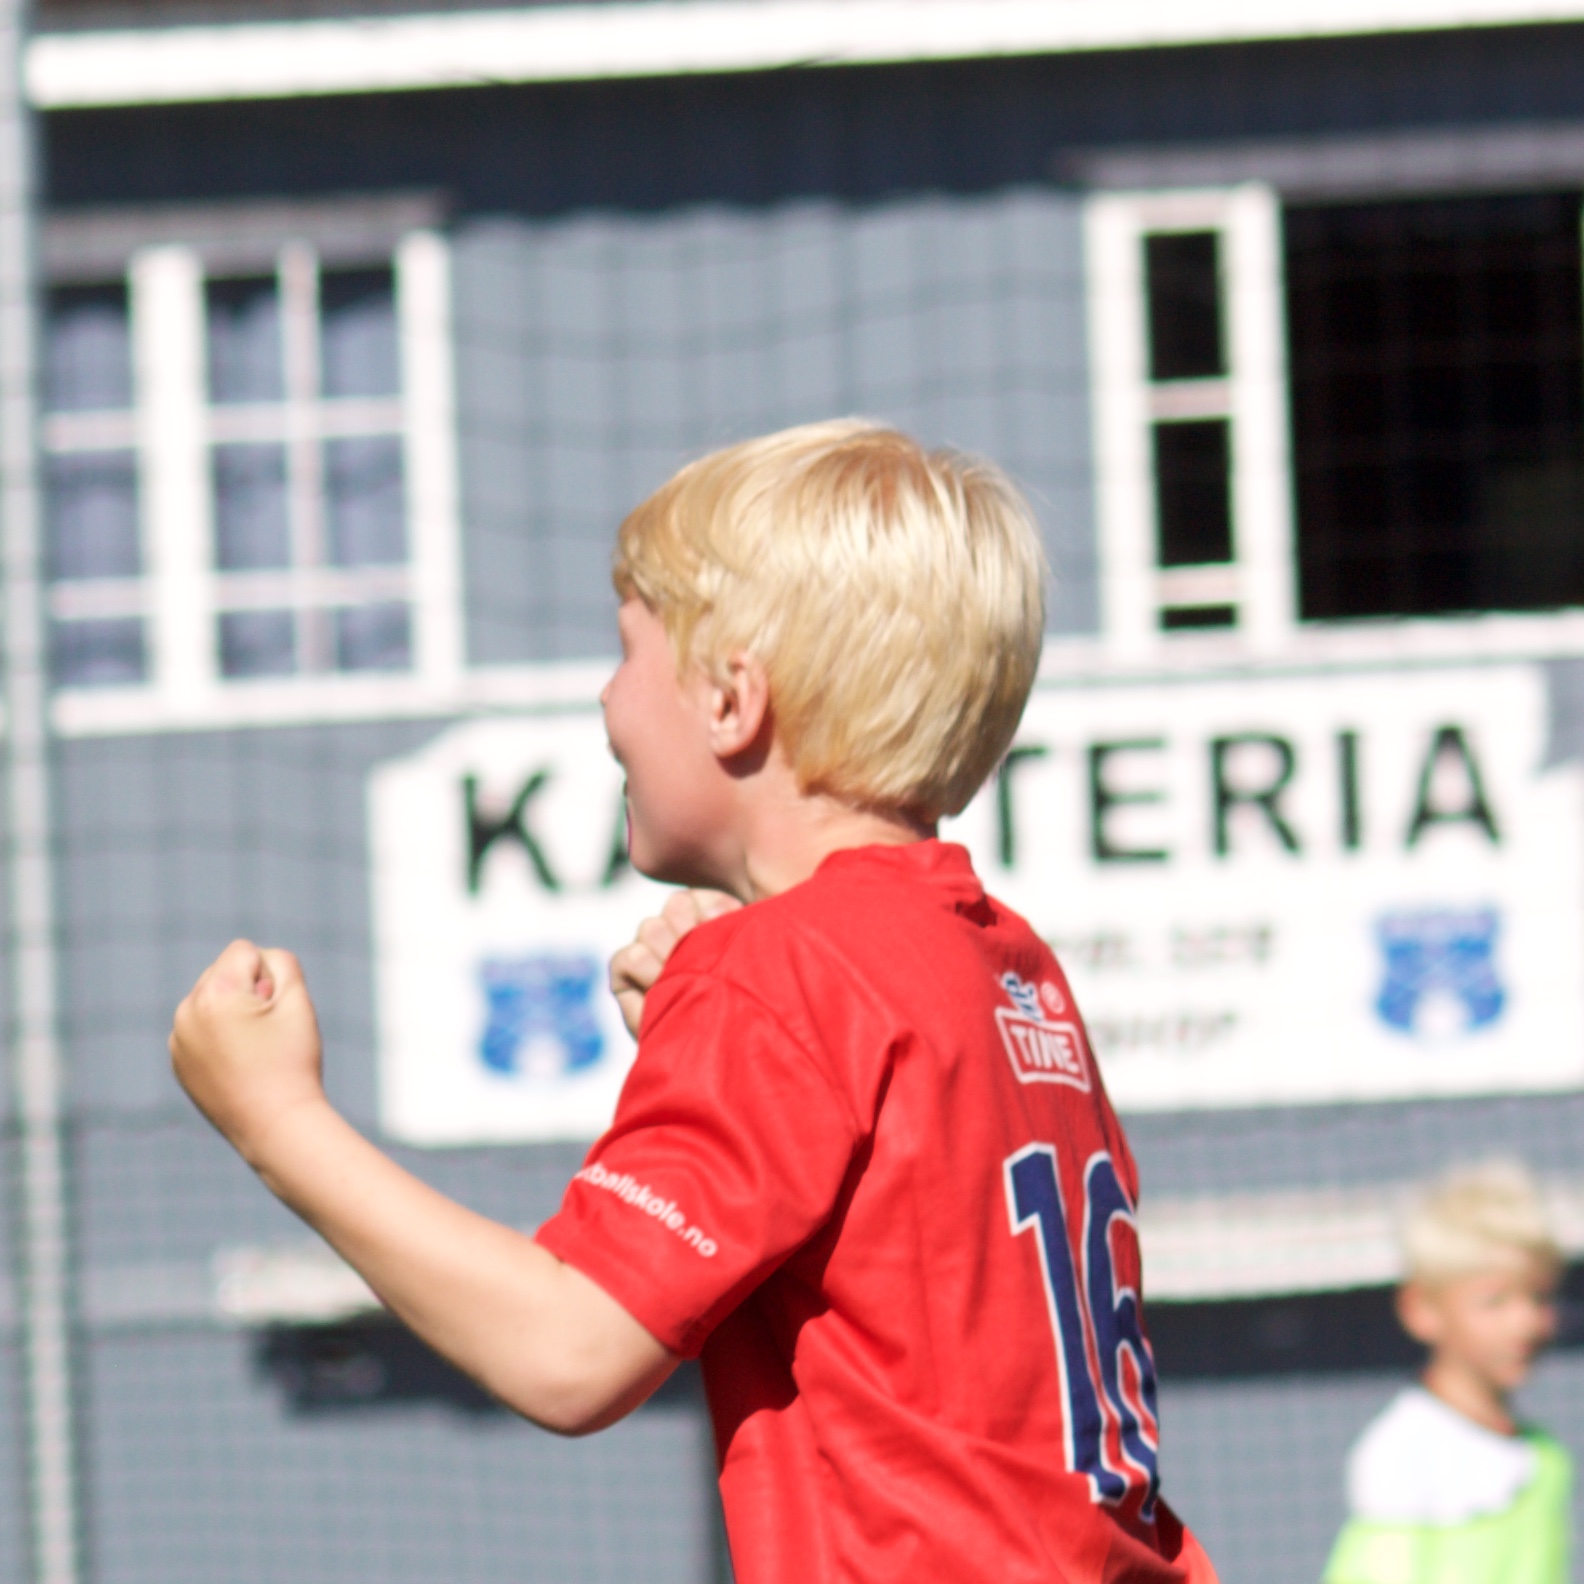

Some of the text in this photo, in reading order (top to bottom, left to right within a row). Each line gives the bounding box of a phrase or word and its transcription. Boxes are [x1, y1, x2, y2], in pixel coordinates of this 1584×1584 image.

[460, 725, 1502, 895] KTERIA
[1009, 1025, 1080, 1074] TINE
[1003, 1141, 1159, 1523] 16
